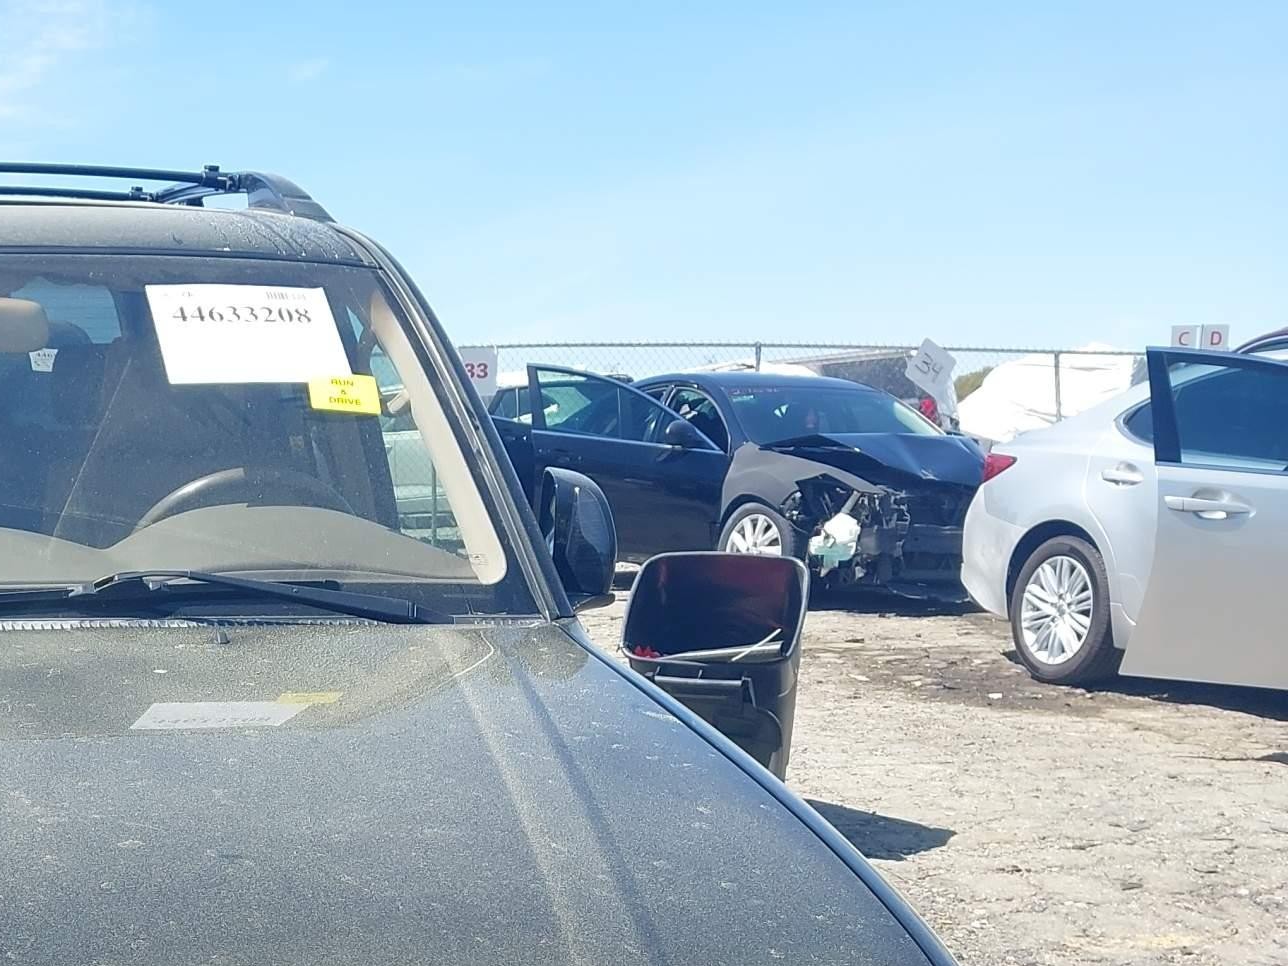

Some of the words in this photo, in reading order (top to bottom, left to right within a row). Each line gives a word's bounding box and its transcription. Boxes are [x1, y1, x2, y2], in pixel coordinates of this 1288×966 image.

[171, 305, 312, 323] 44633208
[1178, 331, 1190, 346] C
[1210, 331, 1222, 346] D
[464, 362, 488, 379] 33
[329, 396, 361, 406] DRIVE
